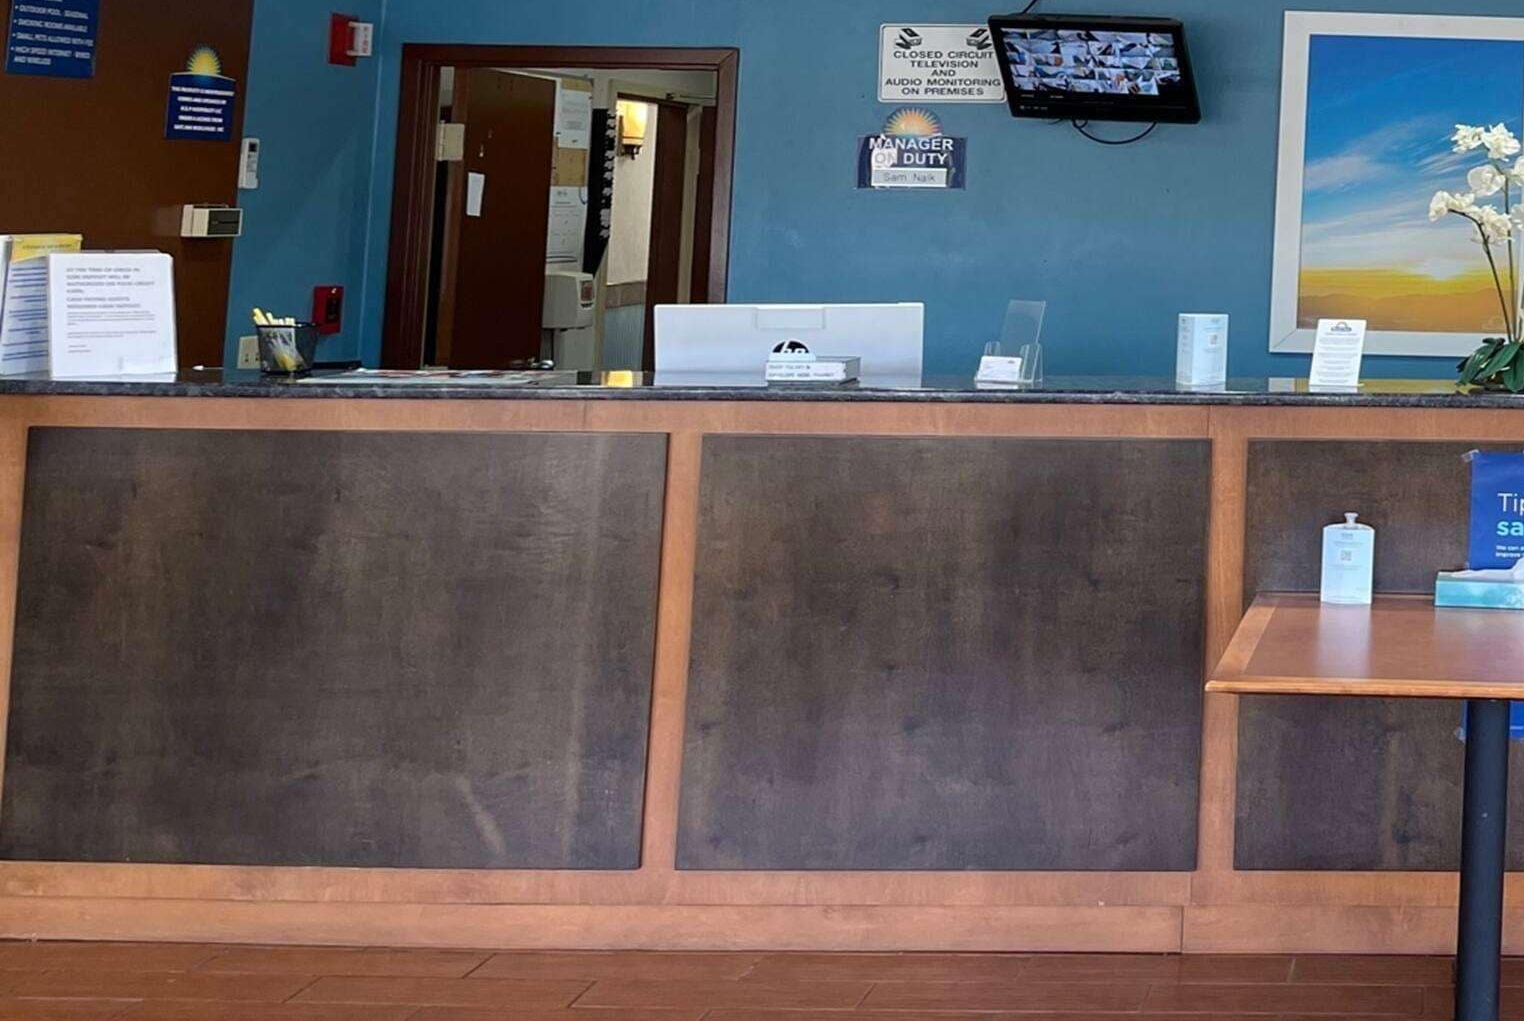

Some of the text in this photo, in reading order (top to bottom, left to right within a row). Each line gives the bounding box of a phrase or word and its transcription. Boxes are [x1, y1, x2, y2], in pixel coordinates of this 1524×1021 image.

[893, 50, 994, 59] CLOSED CIRCUIT
[910, 60, 979, 68] TELEVISION
[931, 69, 956, 77] AND
[885, 78, 1001, 87] AUDIO MONITORING
[901, 87, 984, 95] ON PREMISES
[868, 137, 954, 151] MANAGER
[875, 152, 948, 165] ON DUTY
